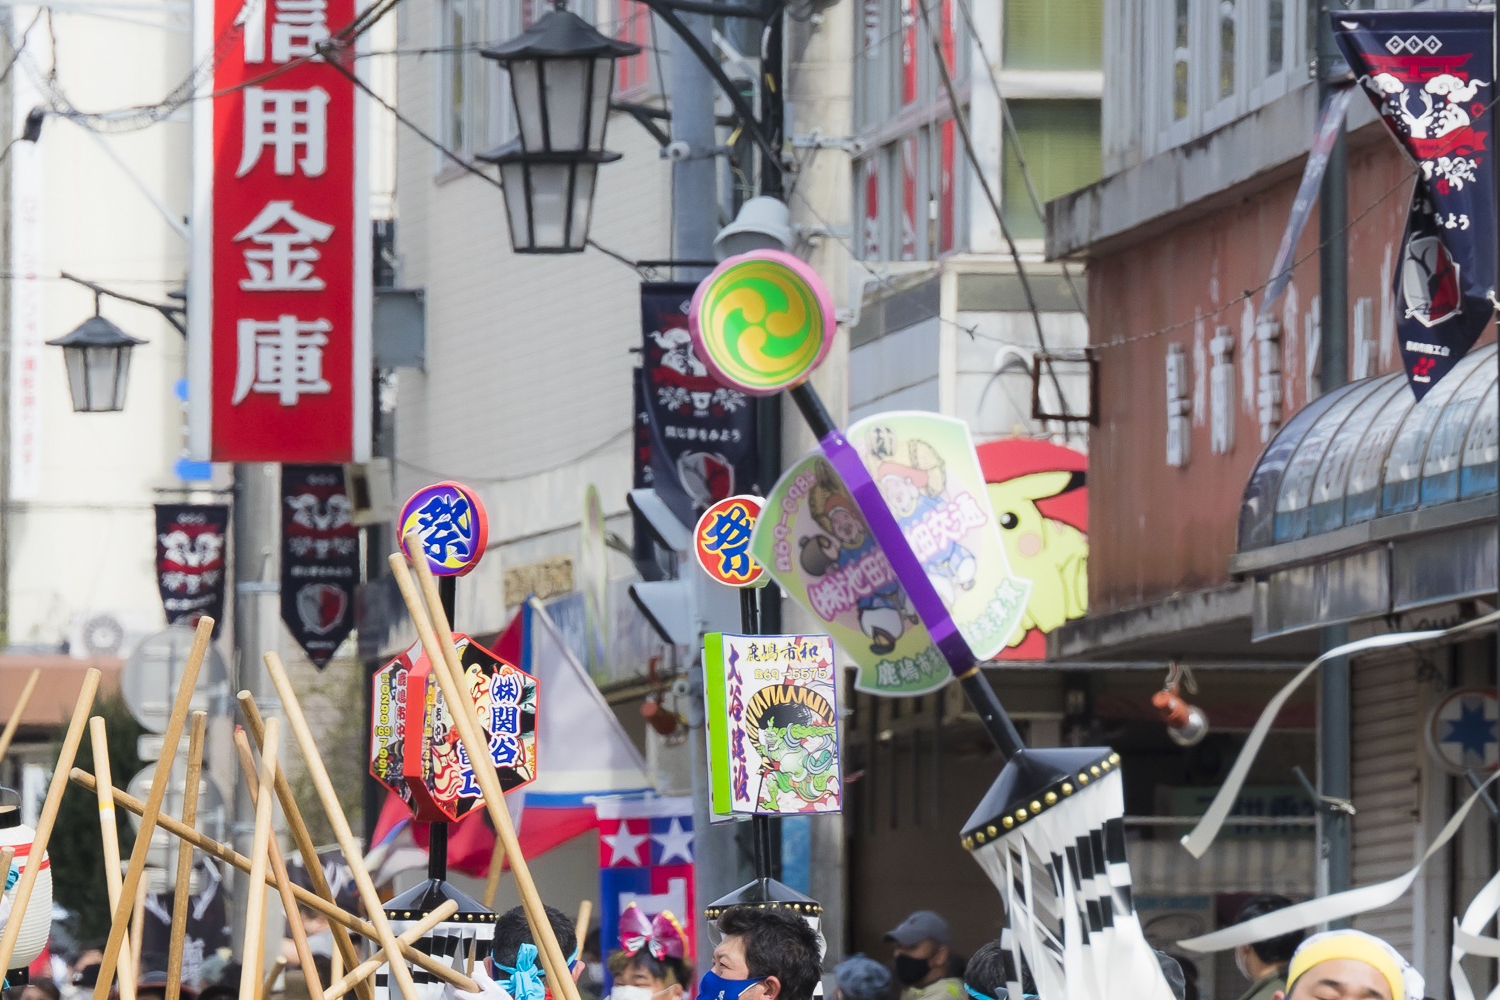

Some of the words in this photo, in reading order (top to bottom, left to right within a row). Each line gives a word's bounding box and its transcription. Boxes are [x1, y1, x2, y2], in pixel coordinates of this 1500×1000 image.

[232, 0, 336, 407] 信用金庫
[406, 496, 471, 565] 祭
[703, 505, 760, 578] 祭
[909, 493, 987, 562] 田交通
[746, 642, 819, 662] 鹿嶋市和
[727, 643, 750, 802] 大谷建設
